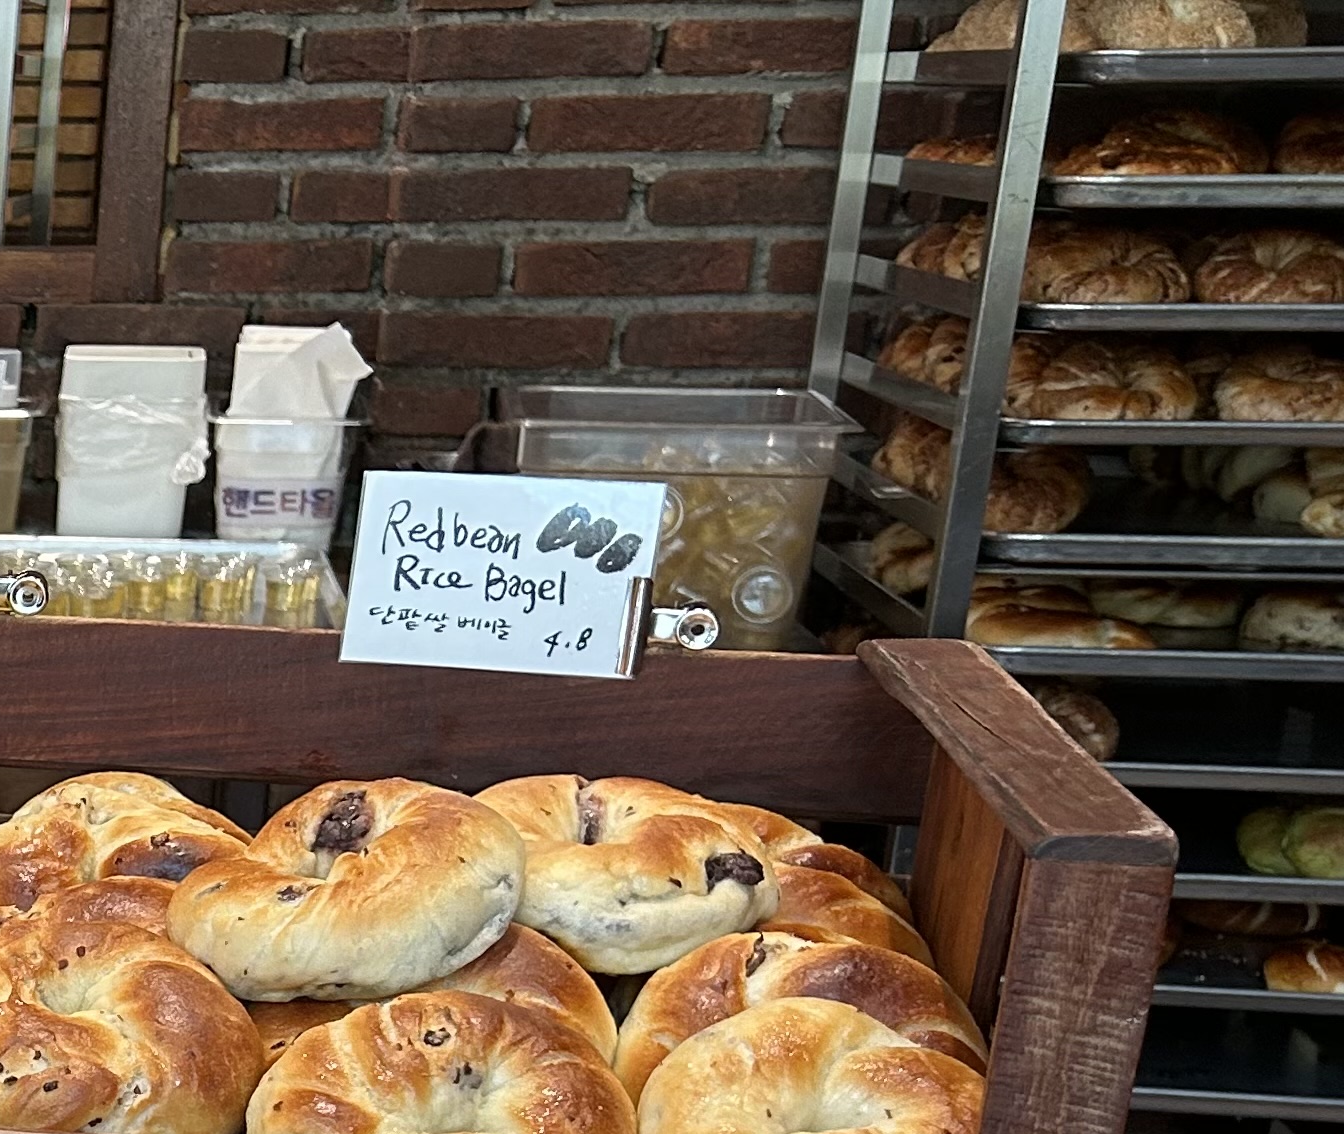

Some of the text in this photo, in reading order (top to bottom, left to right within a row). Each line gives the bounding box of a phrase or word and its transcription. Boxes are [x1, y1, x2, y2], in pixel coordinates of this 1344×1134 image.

[394, 554, 567, 614] Rice Bagel
[369, 605, 593, 658] 단팥쌀 베이글 4.8
